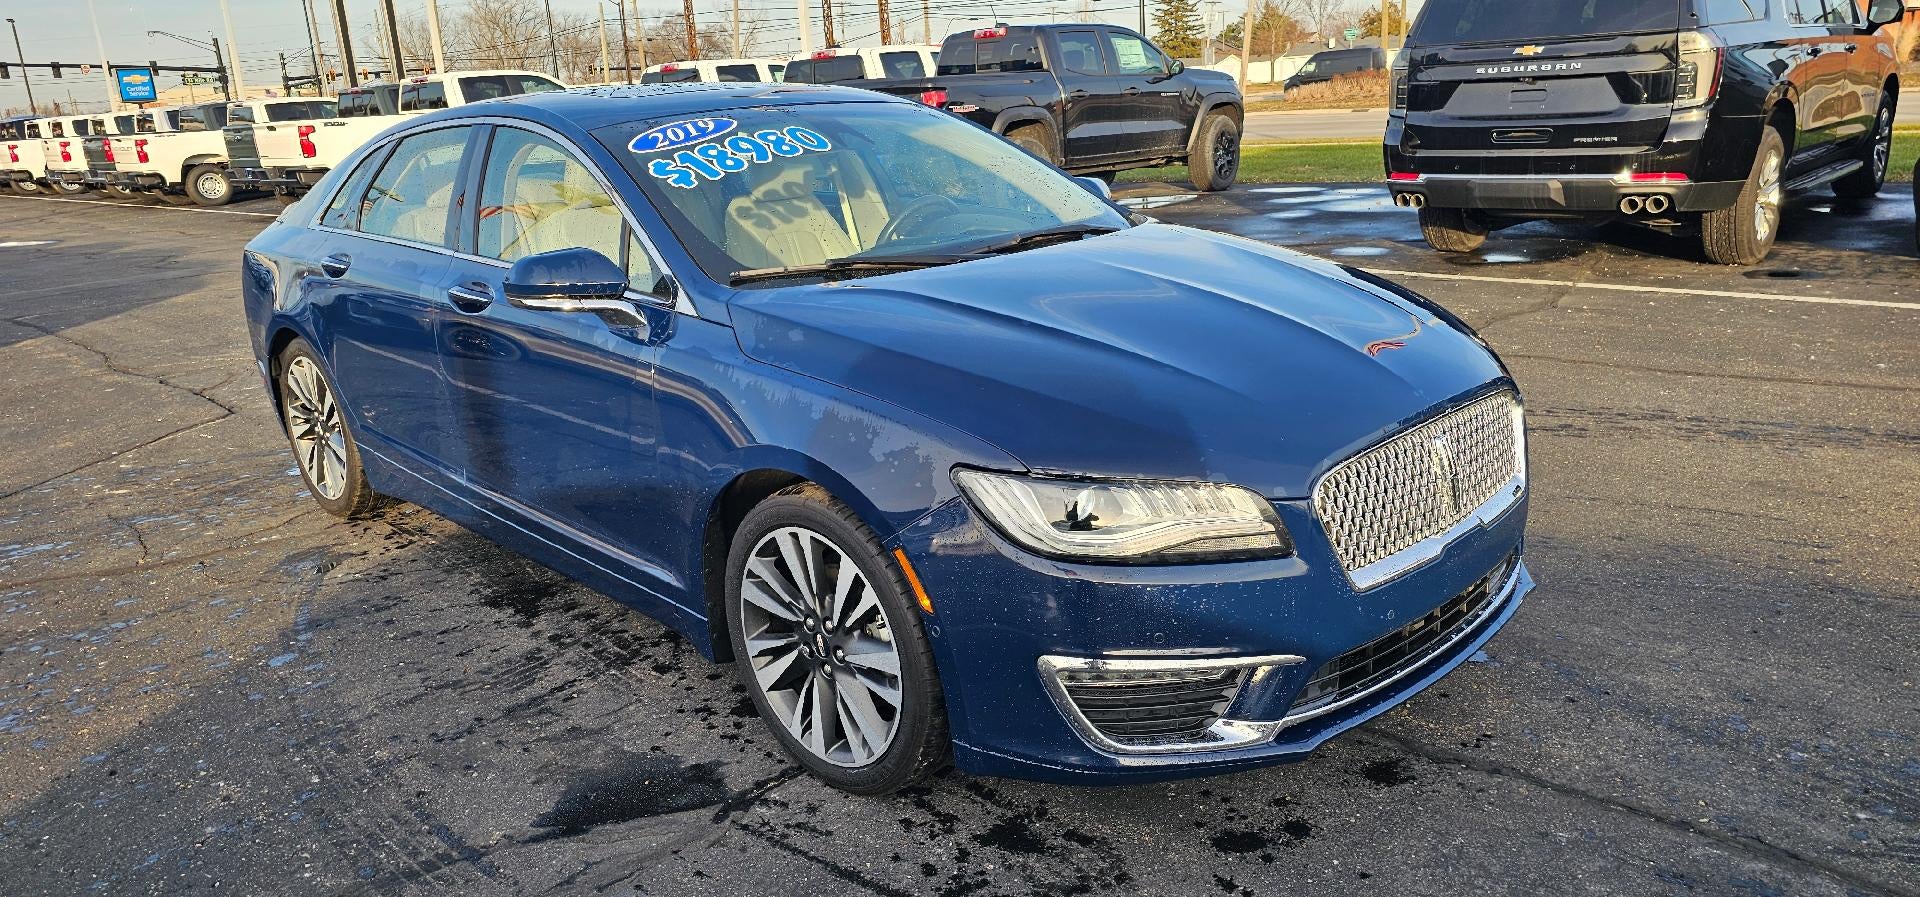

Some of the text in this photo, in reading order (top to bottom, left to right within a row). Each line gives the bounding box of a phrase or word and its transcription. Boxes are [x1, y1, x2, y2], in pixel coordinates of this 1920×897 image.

[1475, 62, 1582, 74] SUBURBAN
[649, 118, 716, 149] 2019
[648, 125, 832, 189] $18980
